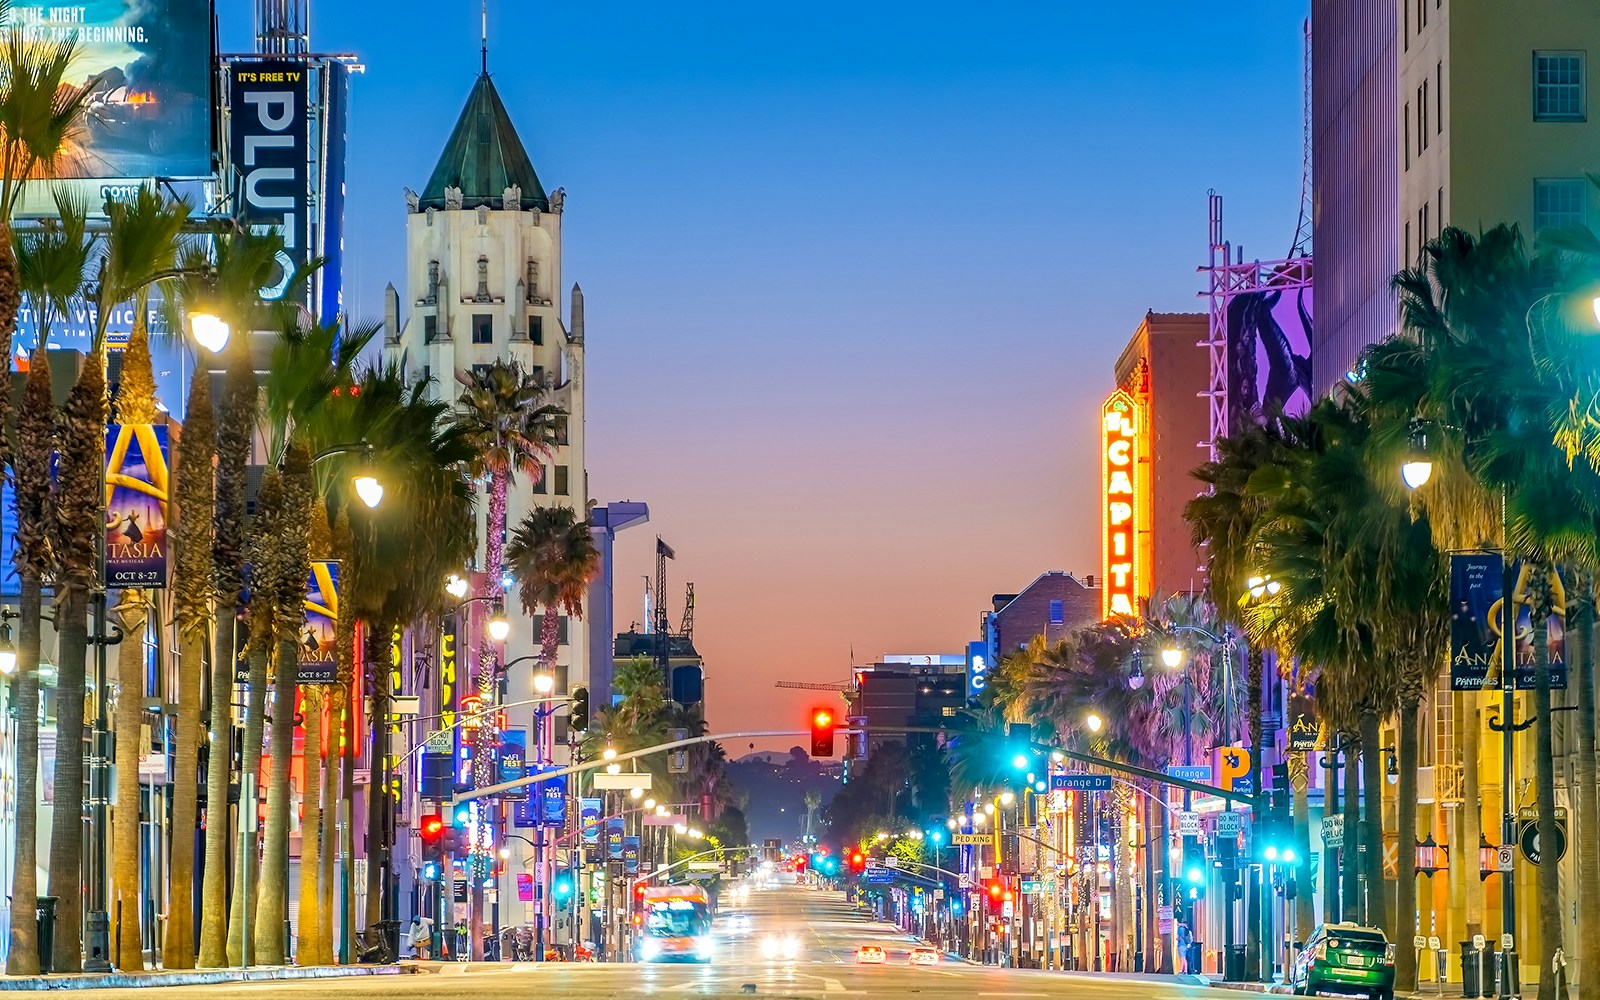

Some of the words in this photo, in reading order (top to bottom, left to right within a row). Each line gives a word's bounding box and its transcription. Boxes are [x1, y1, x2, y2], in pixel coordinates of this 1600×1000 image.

[22, 7, 44, 22] THE
[49, 7, 86, 23] NIGHT
[50, 27, 73, 42] THE
[78, 26, 149, 43] BEGINNING.
[237, 72, 257, 82] IT'S
[259, 72, 284, 82] FREE
[285, 72, 300, 82] TV
[115, 572, 136, 580] OCT
[138, 571, 157, 580] 8-27
[1174, 769, 1205, 779] Orange
[1056, 778, 1091, 789] Orange
[1095, 778, 1107, 786] Dr
[1233, 786, 1251, 794] Parking
[1324, 820, 1333, 828] DO
